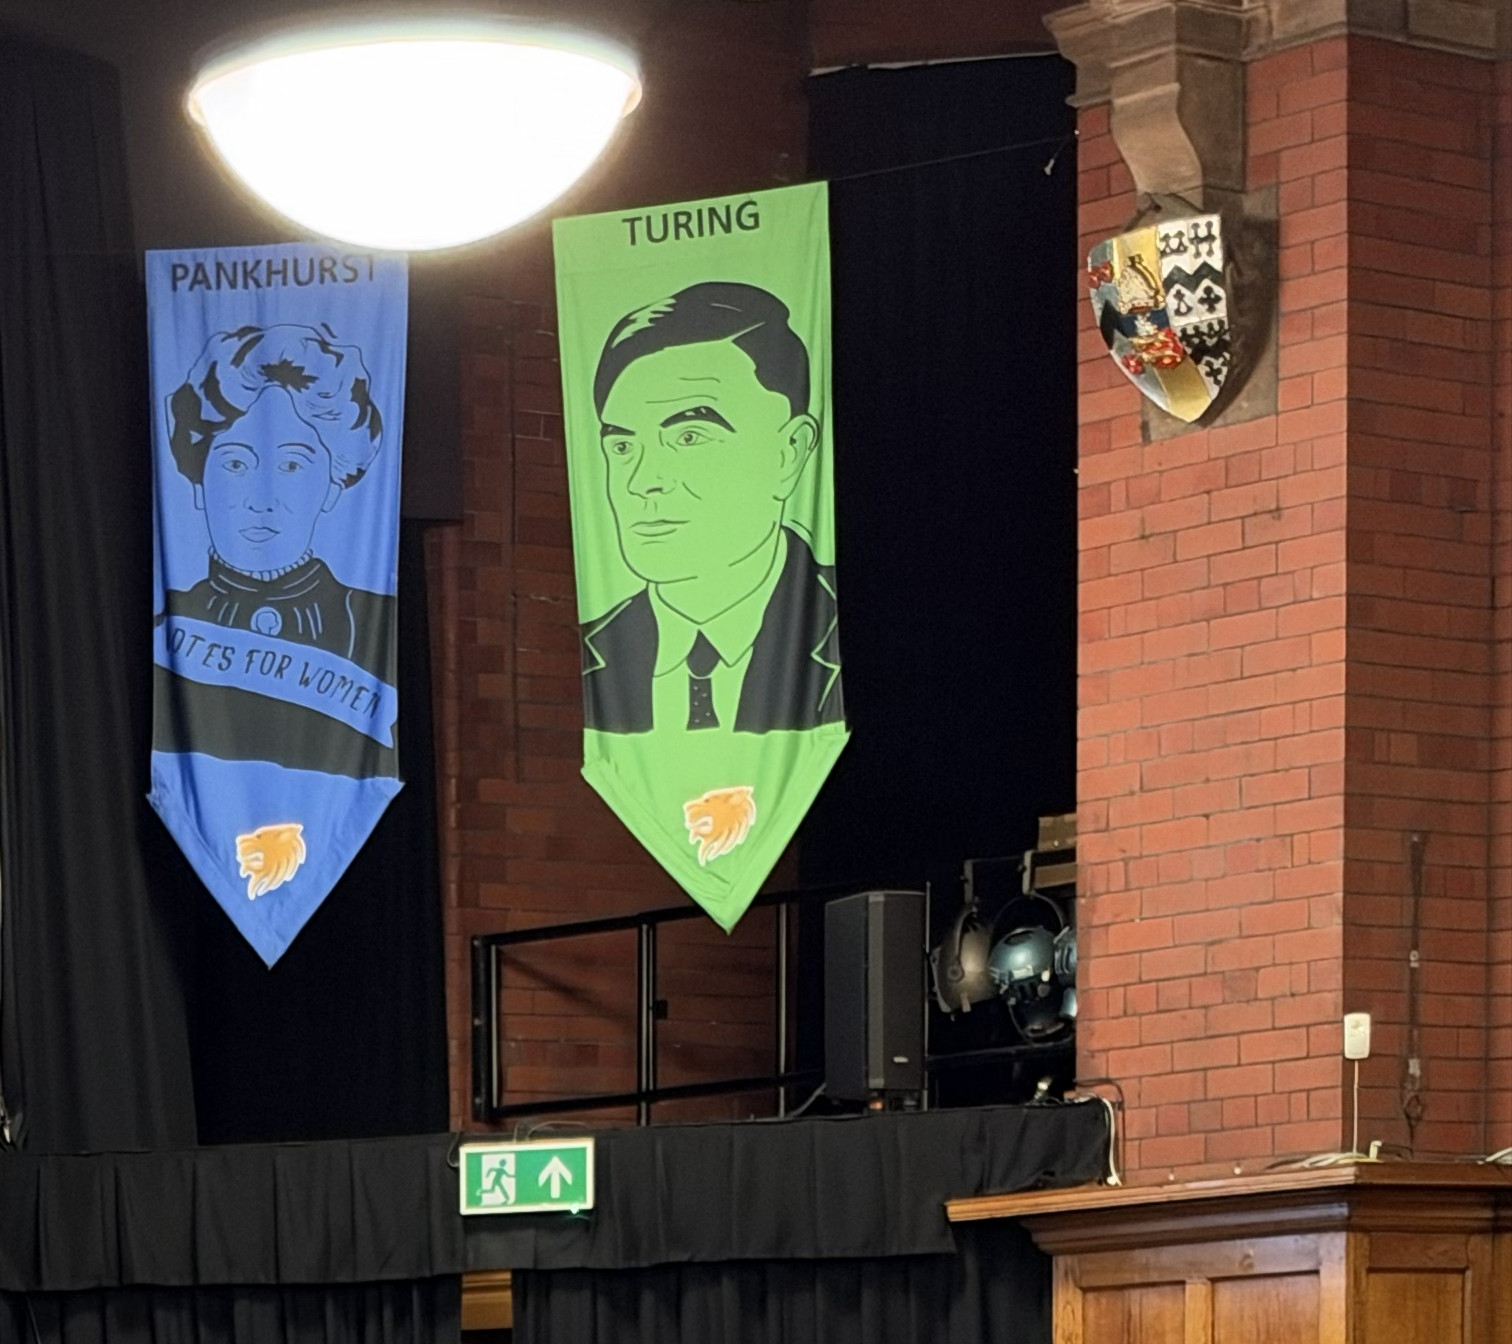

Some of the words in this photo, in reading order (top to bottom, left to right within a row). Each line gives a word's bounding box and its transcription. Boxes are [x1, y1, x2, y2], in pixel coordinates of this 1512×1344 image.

[621, 200, 760, 246] TURING
[171, 254, 374, 293] PANKHURST
[171, 628, 235, 671] OTES
[245, 648, 292, 679] FOR
[299, 662, 383, 719] WOMEN
